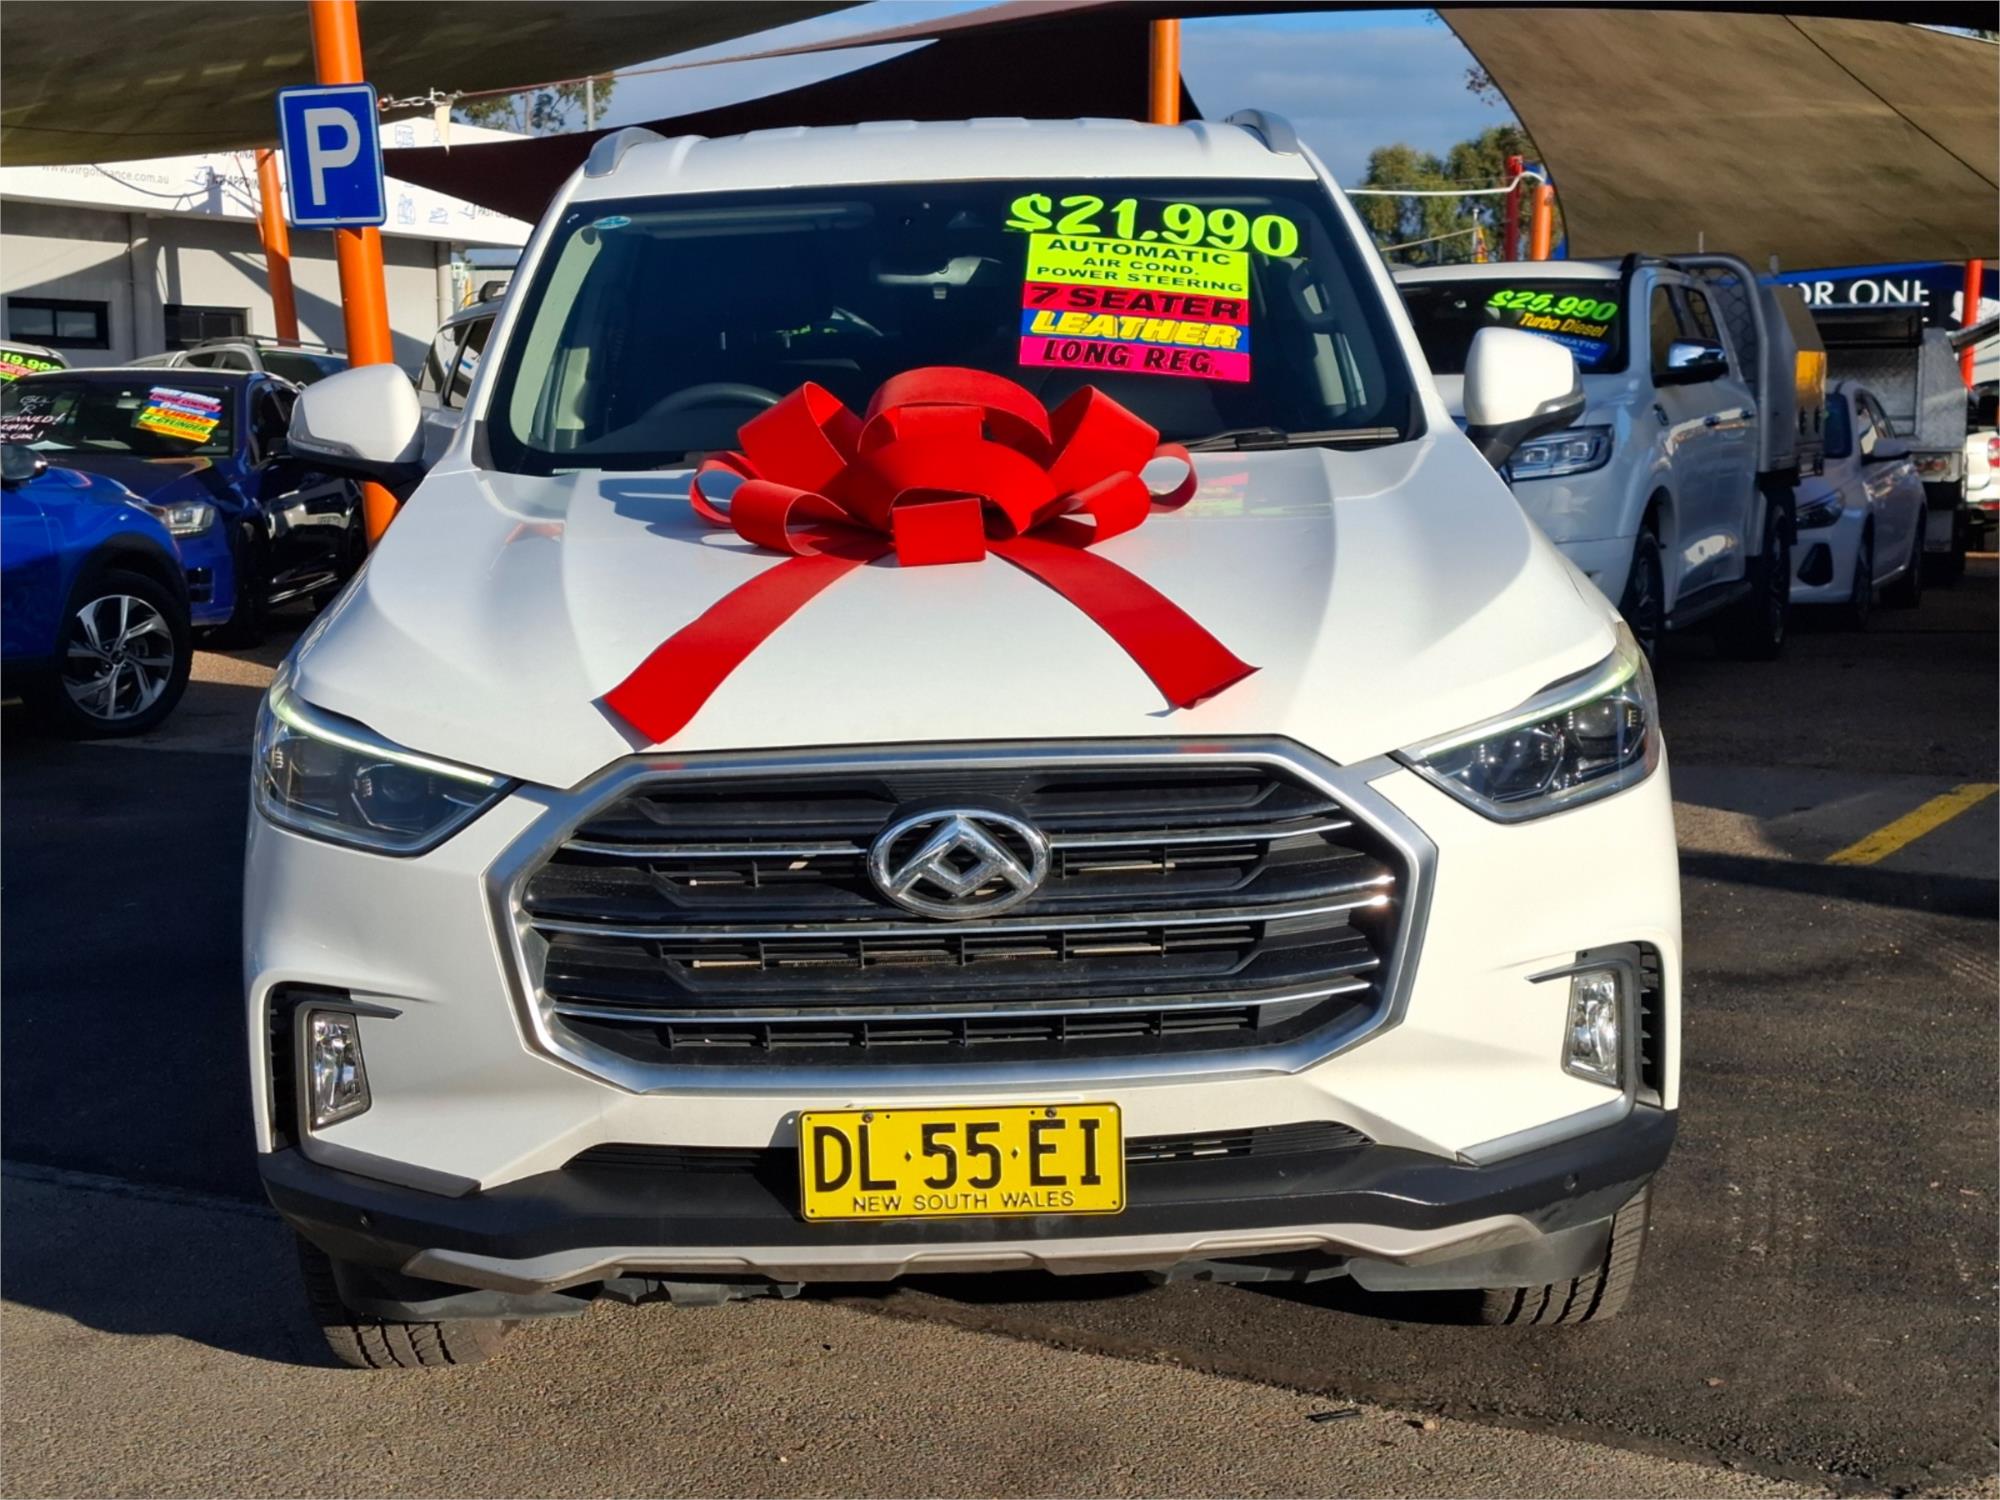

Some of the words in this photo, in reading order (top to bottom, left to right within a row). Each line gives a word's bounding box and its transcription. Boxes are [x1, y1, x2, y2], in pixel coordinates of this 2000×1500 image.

[303, 106, 361, 206] P
[41, 164, 170, 185] www.virgoance.com.au
[1005, 193, 1298, 257] $21.990
[1047, 238, 1231, 266] AUTOMATIC
[1083, 256, 1121, 269] AIR
[1129, 259, 1200, 276] COND.
[1036, 266, 1118, 281] POWER
[1127, 272, 1243, 292] STEERING
[1848, 279, 1930, 307] ONE
[1031, 286, 1060, 304] 7
[1067, 287, 1241, 320] SEATER
[1487, 290, 1619, 321] $25.990
[1030, 310, 1243, 350] LEATHER
[1519, 312, 1561, 331] Turbo
[1559, 318, 1609, 338] Diesel
[1042, 339, 1130, 367] LONG
[1143, 346, 1225, 376] REG.
[852, 1196, 901, 1212] NEW
[912, 1193, 988, 1211] SOUTH
[1001, 1190, 1075, 1208] WALES
